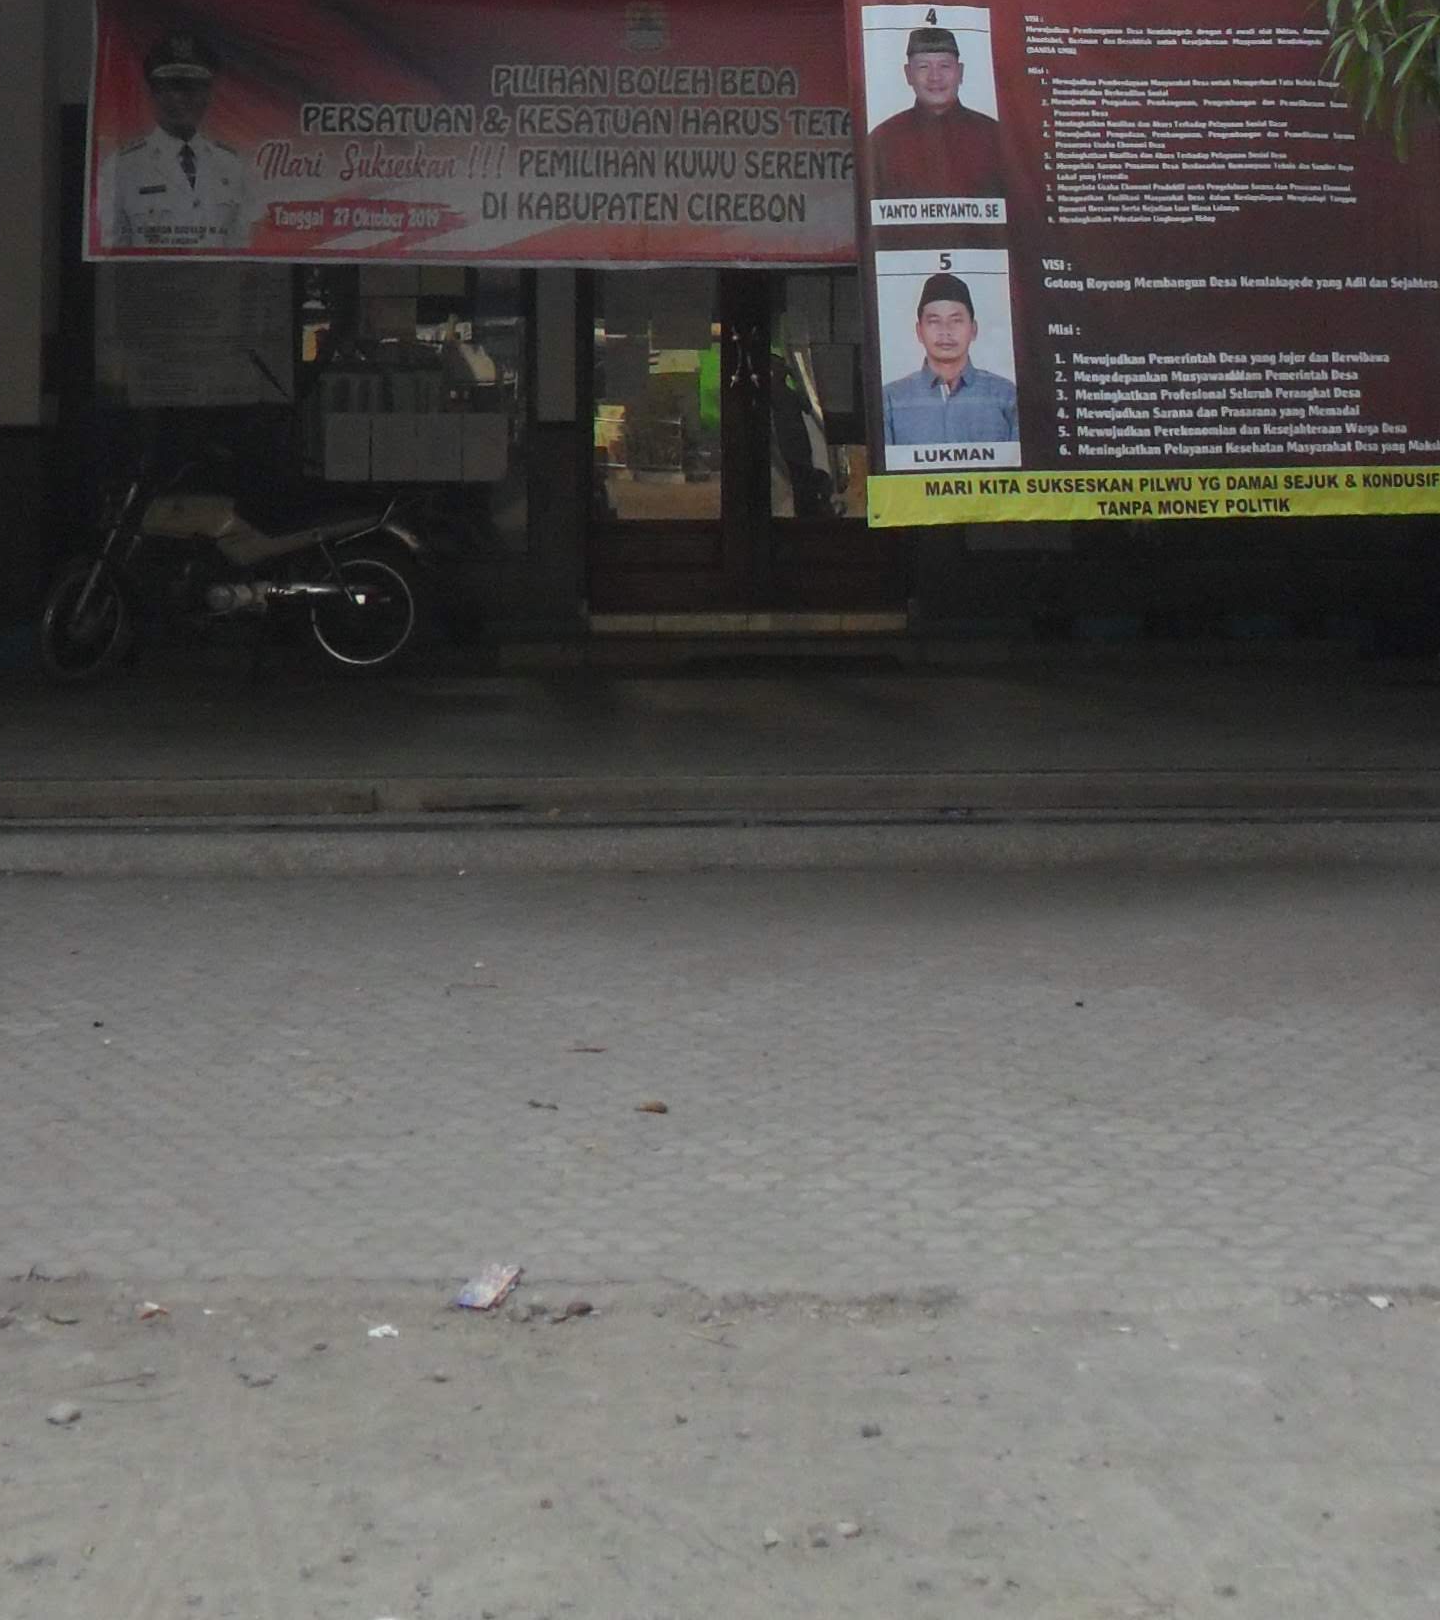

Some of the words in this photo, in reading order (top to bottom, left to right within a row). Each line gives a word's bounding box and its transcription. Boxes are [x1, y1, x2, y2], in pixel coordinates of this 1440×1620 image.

[926, 7, 937, 26] 4
[493, 66, 608, 95] PILIHAN
[617, 66, 711, 95] BOLEH
[720, 67, 797, 95] BEDA
[303, 105, 472, 133] PERSATUAN
[482, 105, 509, 133] &
[518, 106, 671, 135] KESATUAN
[681, 107, 779, 136] HARUS
[257, 141, 323, 180] Mari
[340, 141, 457, 181] Sukseskan
[467, 142, 506, 179] !!!
[518, 148, 655, 178] PEMILIHAN
[665, 149, 737, 179] KUWU
[482, 191, 507, 220] DI
[518, 191, 678, 222] KABUPATEN
[687, 192, 806, 223] CIREBON
[879, 204, 917, 219] YANTO
[985, 203, 999, 218] SE
[274, 207, 323, 230] Tanggal
[352, 208, 404, 228] Oktober
[407, 207, 440, 228] 2019
[939, 253, 952, 270] 5
[1041, 259, 1065, 271] VISI
[1044, 277, 1084, 291] Gotong
[1086, 277, 1131, 291] Royong
[1134, 276, 1207, 290] Membangun
[1210, 276, 1237, 288] Desa
[1316, 278, 1343, 291] yang
[1345, 277, 1367, 288] Adil
[1369, 277, 1388, 288] dan
[1048, 324, 1074, 336] Misi
[1055, 353, 1066, 365] 1.
[1072, 353, 1145, 367] Mewujudkan
[1148, 352, 1216, 364] Pemerintah
[1219, 352, 1247, 363] Desa
[1250, 353, 1276, 365] yang
[1278, 352, 1305, 364] Jujur
[1309, 352, 1329, 363] dan
[1054, 370, 1068, 382] 2.
[1265, 369, 1328, 381] Pemerintah
[1331, 369, 1358, 380] Desa
[1056, 389, 1068, 401] 3.
[1075, 388, 1158, 403] Meningkatkan
[1160, 388, 1226, 400] Profesional
[1229, 387, 1273, 399] Seluruh
[1275, 387, 1331, 401] Perangkat
[1334, 387, 1361, 398] Desa
[1056, 407, 1070, 419] 4.
[1076, 406, 1150, 421] Mewujudkan
[1153, 406, 1193, 418] Sarana
[1196, 406, 1218, 418] dan
[1221, 405, 1277, 417] Prasarana
[1279, 406, 1306, 419] yang
[1308, 404, 1360, 416] Memadai
[1058, 425, 1070, 438] 5.
[1077, 425, 1151, 439] Mewujudkan
[1239, 424, 1260, 436] dan
[1345, 422, 1379, 436] Warga
[1382, 422, 1407, 433] Desa
[914, 447, 995, 463] LUKMAN
[1059, 444, 1071, 456] 6.
[1078, 443, 1160, 458] Meningkatkan
[1164, 442, 1223, 457] Pelayanan
[1226, 441, 1284, 454] Kesehatan
[1355, 440, 1378, 451] Desa
[1381, 441, 1406, 454] yang
[925, 480, 972, 496] MARI
[980, 479, 1020, 495] KITA
[1027, 477, 1133, 494] SUKSESKAN
[1140, 476, 1192, 493] PILWU
[1198, 475, 1220, 491] YG
[1227, 474, 1278, 491] DAMAI
[1283, 473, 1339, 490] SEJUK
[1345, 473, 1357, 488] &
[1362, 472, 1440, 488] KONDUSIF
[1098, 500, 1153, 516] TANPA
[1158, 499, 1219, 515] MONEY
[1225, 497, 1290, 513] POLITIK
